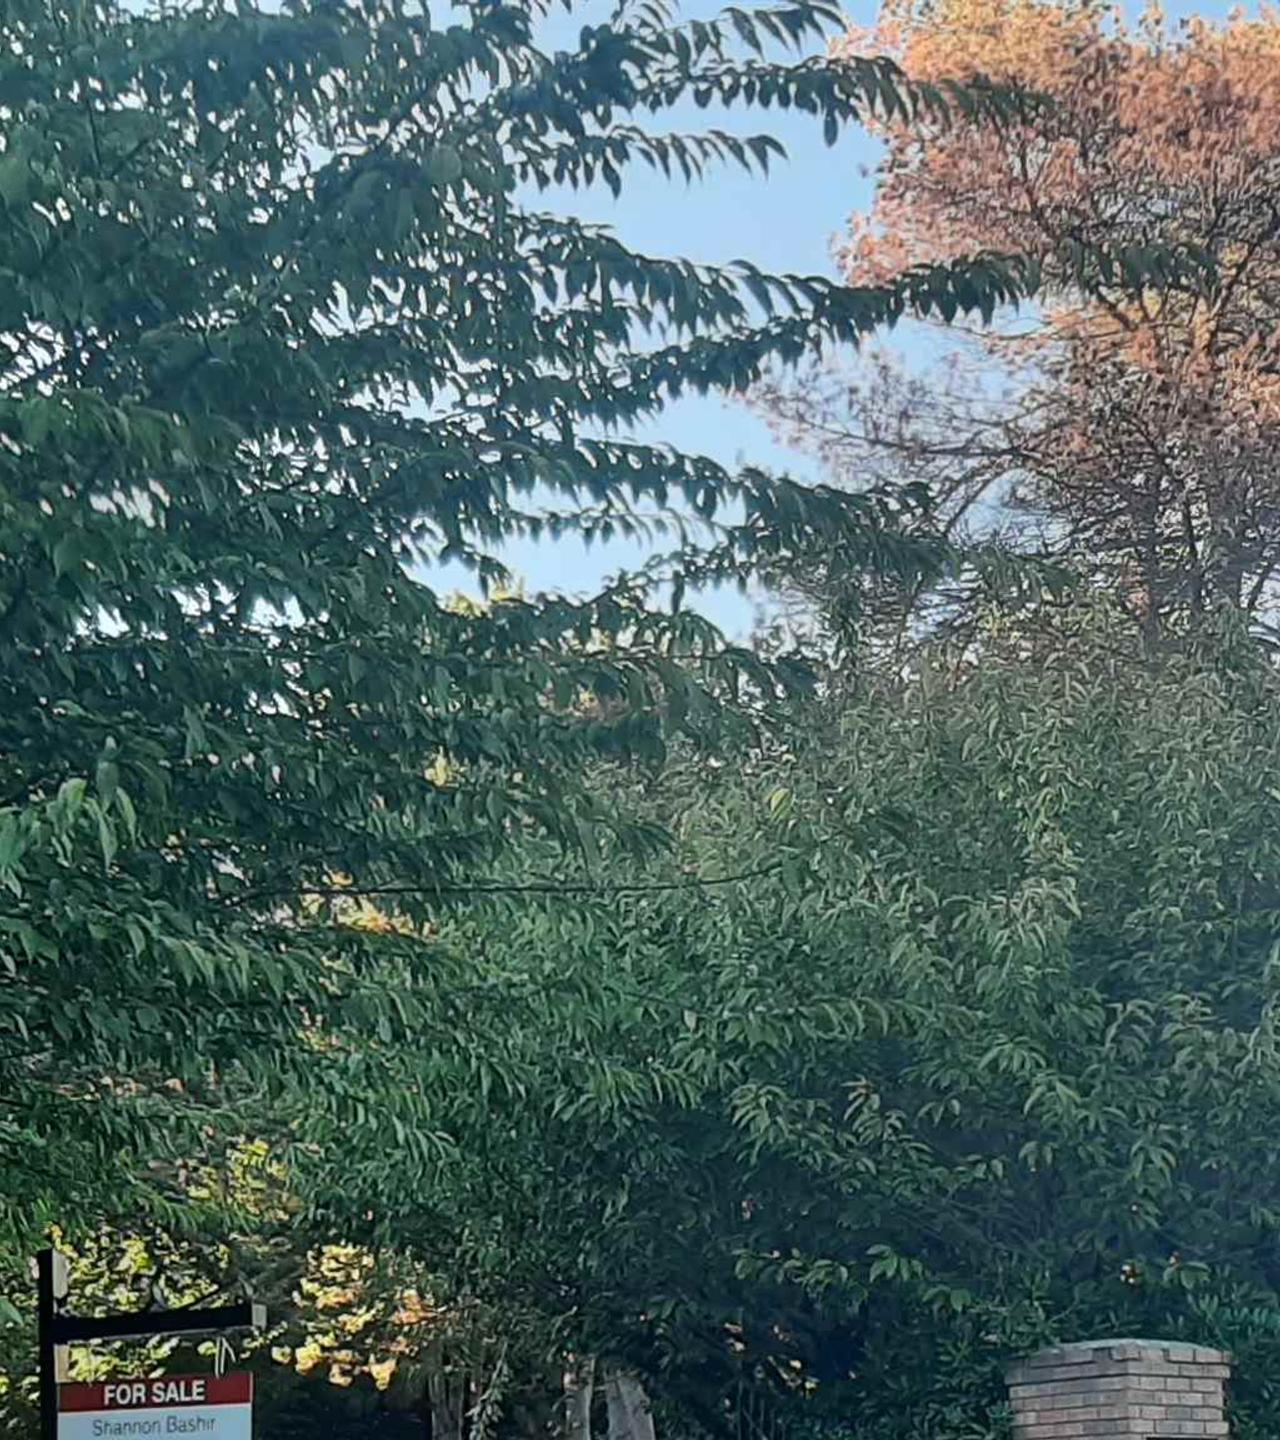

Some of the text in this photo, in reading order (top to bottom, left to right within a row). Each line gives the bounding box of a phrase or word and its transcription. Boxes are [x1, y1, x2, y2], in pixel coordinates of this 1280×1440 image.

[104, 1380, 205, 1405] FOR SALE
[92, 1414, 216, 1437] Shannon Bashir
